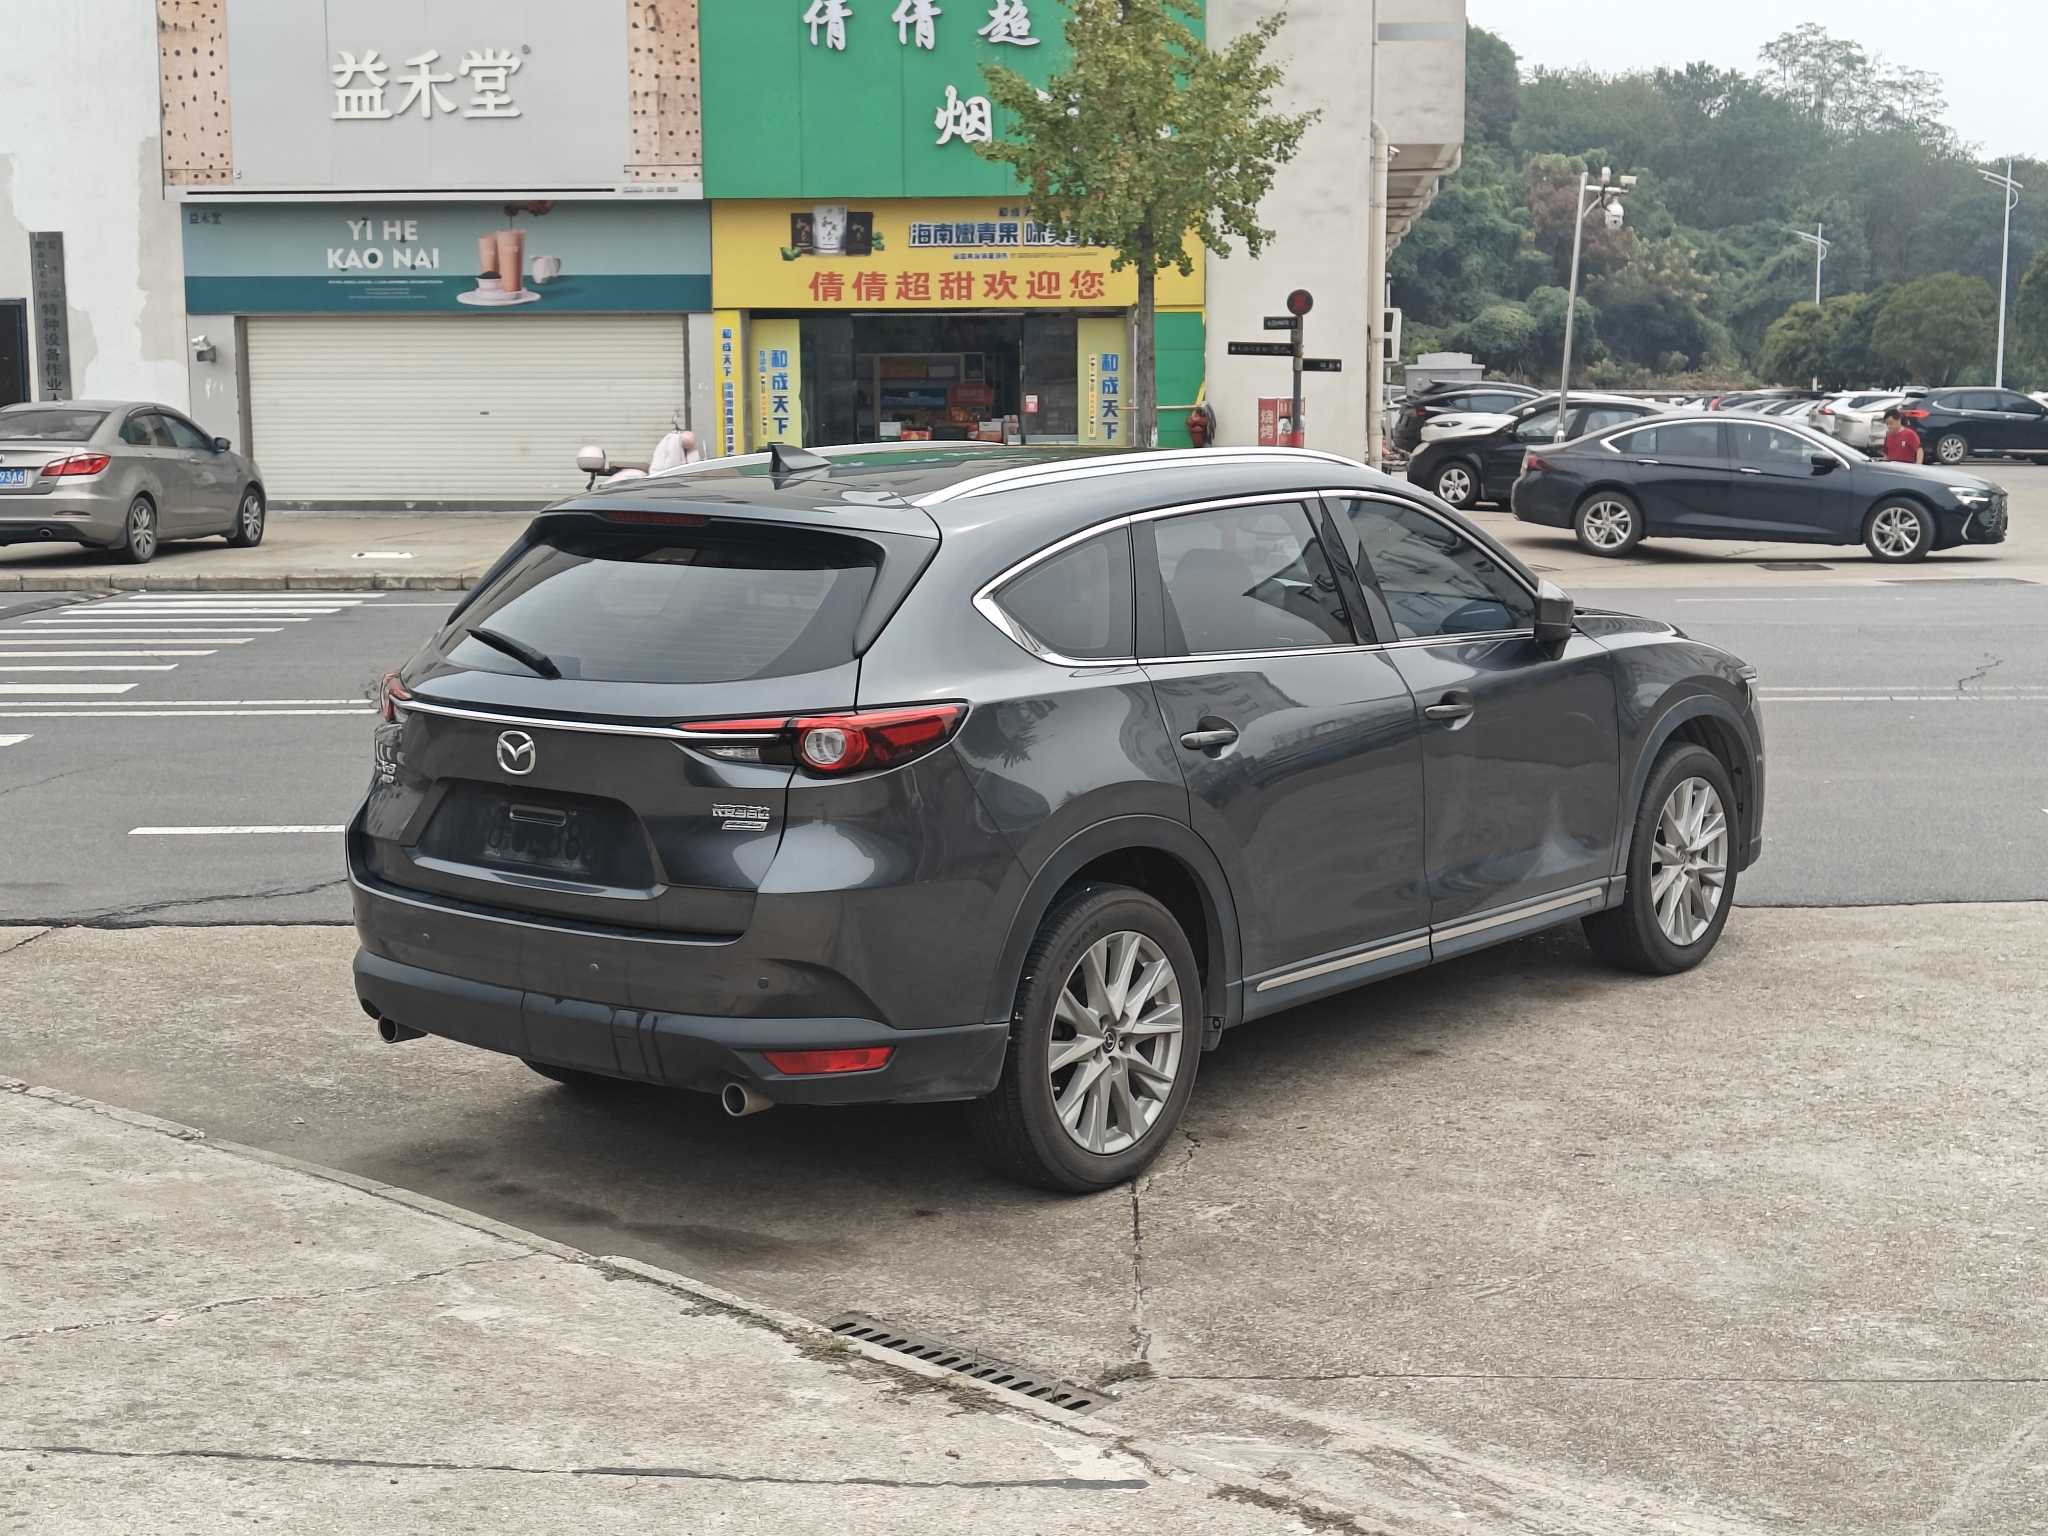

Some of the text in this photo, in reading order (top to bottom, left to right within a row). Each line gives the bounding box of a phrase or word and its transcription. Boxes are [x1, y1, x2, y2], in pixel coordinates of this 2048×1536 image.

[331, 47, 523, 120] 益禾堂
[934, 84, 993, 145] 烟
[347, 219, 419, 242] YI HE
[910, 222, 1020, 246] 海南嫩青果
[326, 247, 440, 271] KAO NAI
[809, 270, 1105, 302] 倩倩超甜欢迎您
[771, 349, 790, 435] 和成天下
[1101, 353, 1119, 440] 和成天下
